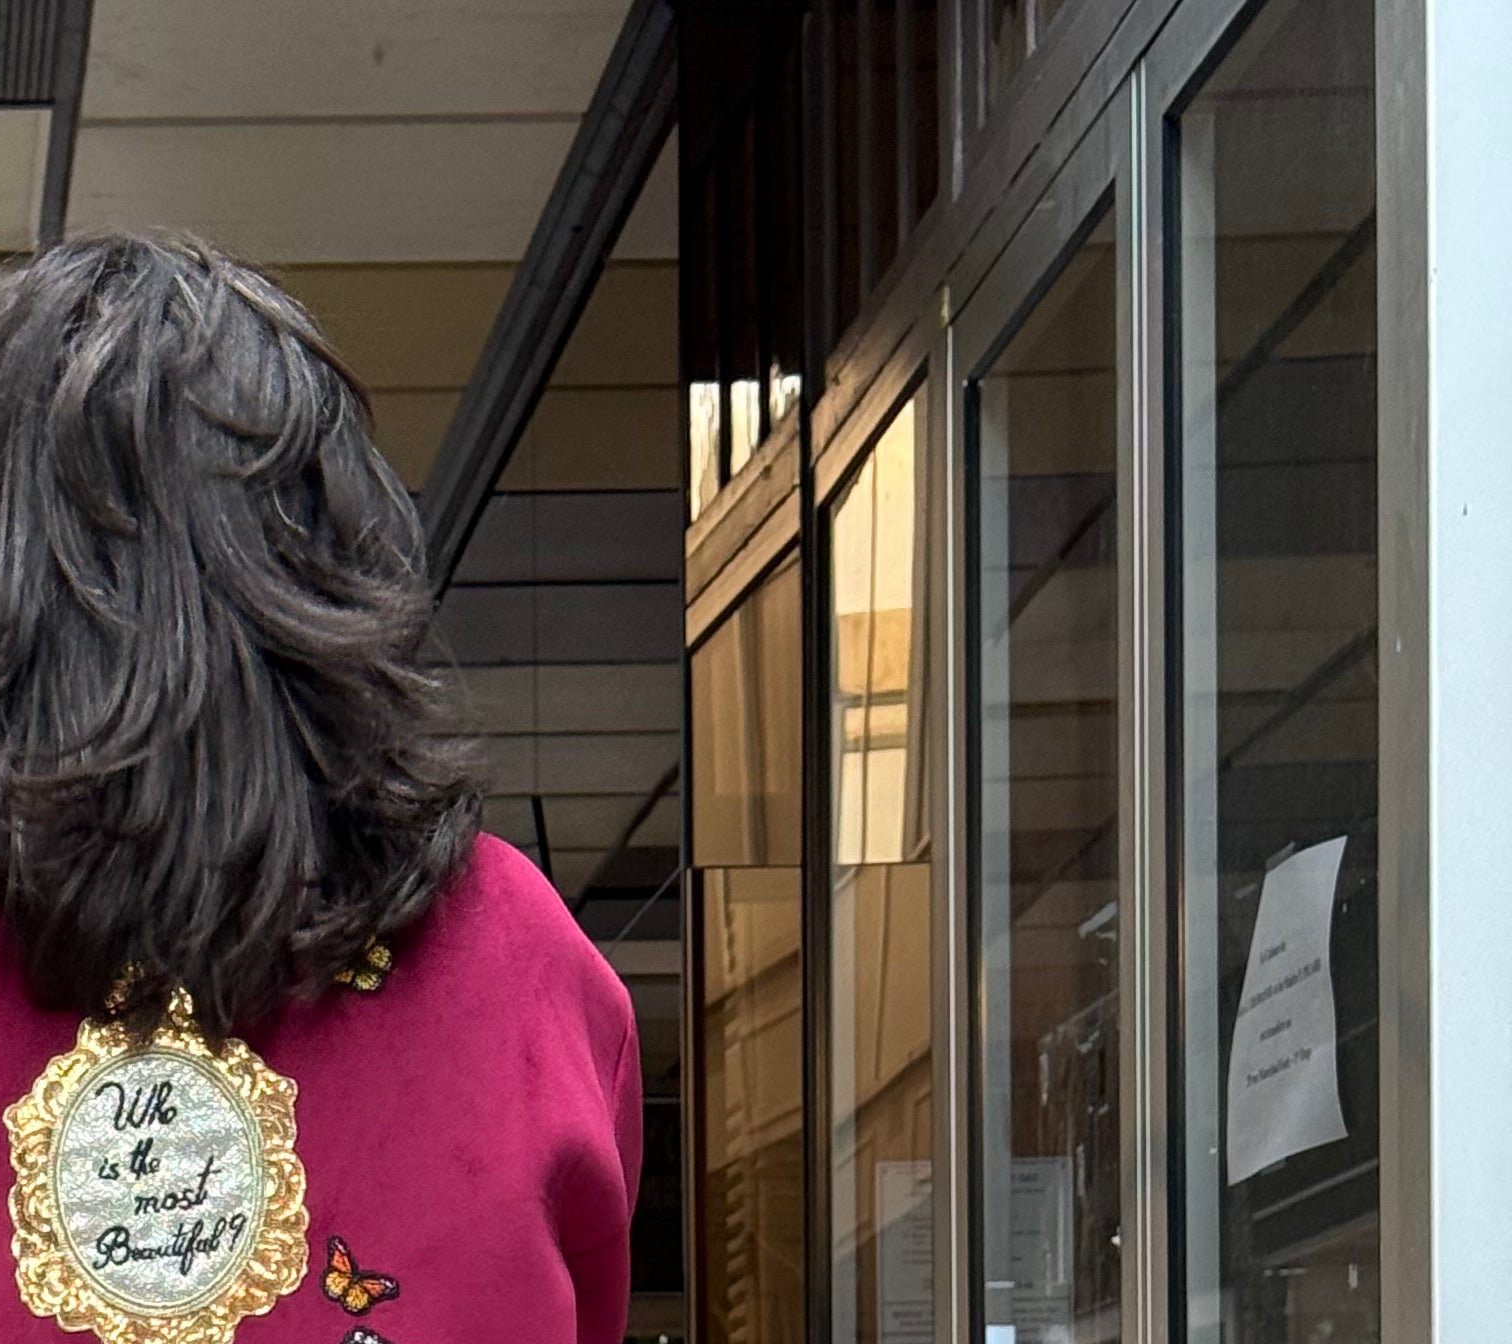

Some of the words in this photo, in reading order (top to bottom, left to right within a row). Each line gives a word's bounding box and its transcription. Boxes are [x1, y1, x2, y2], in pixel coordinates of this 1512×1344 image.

[95, 1081, 177, 1131] Who
[98, 1158, 121, 1181] is
[129, 1137, 161, 1180] the
[134, 1155, 222, 1216] most
